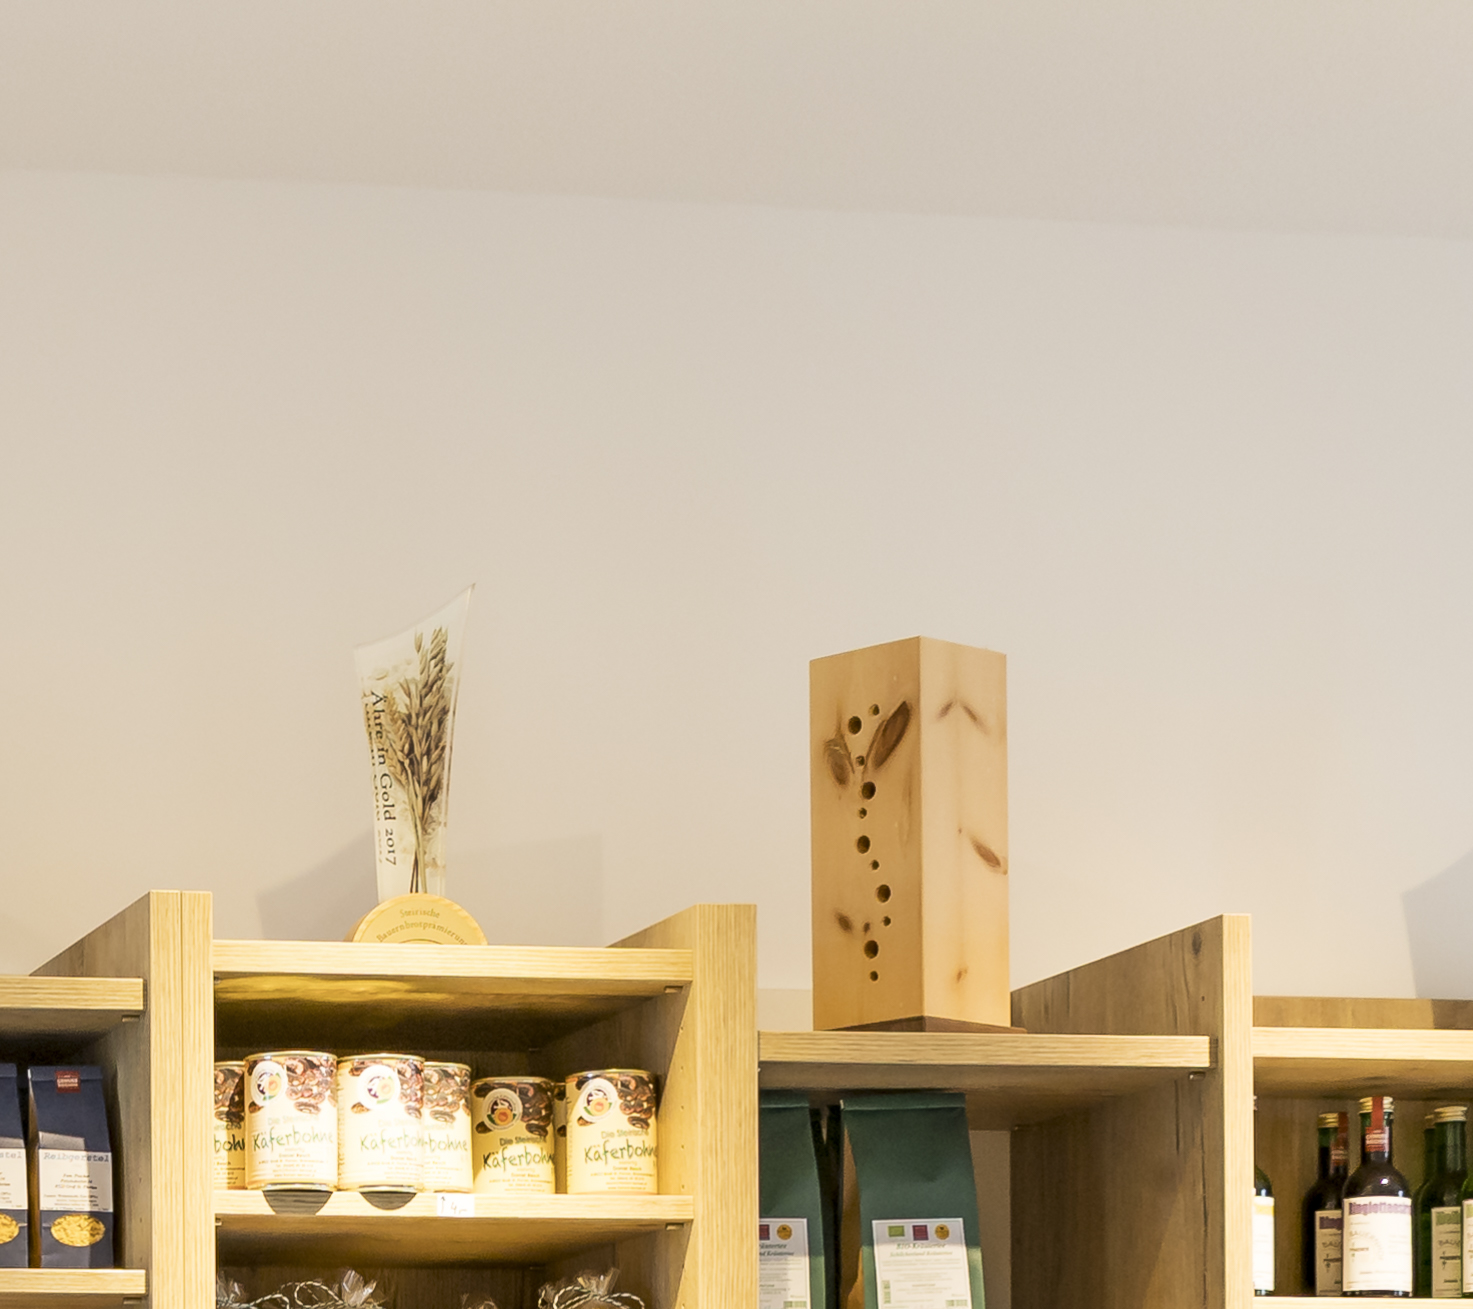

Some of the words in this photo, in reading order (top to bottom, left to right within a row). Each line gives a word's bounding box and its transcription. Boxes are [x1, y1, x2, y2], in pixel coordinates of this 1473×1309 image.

[371, 690, 388, 740] Ähre
[377, 746, 387, 766] in
[378, 772, 397, 822] Gold
[384, 828, 397, 867] 2017
[43, 1152, 110, 1164] Reibgerstel
